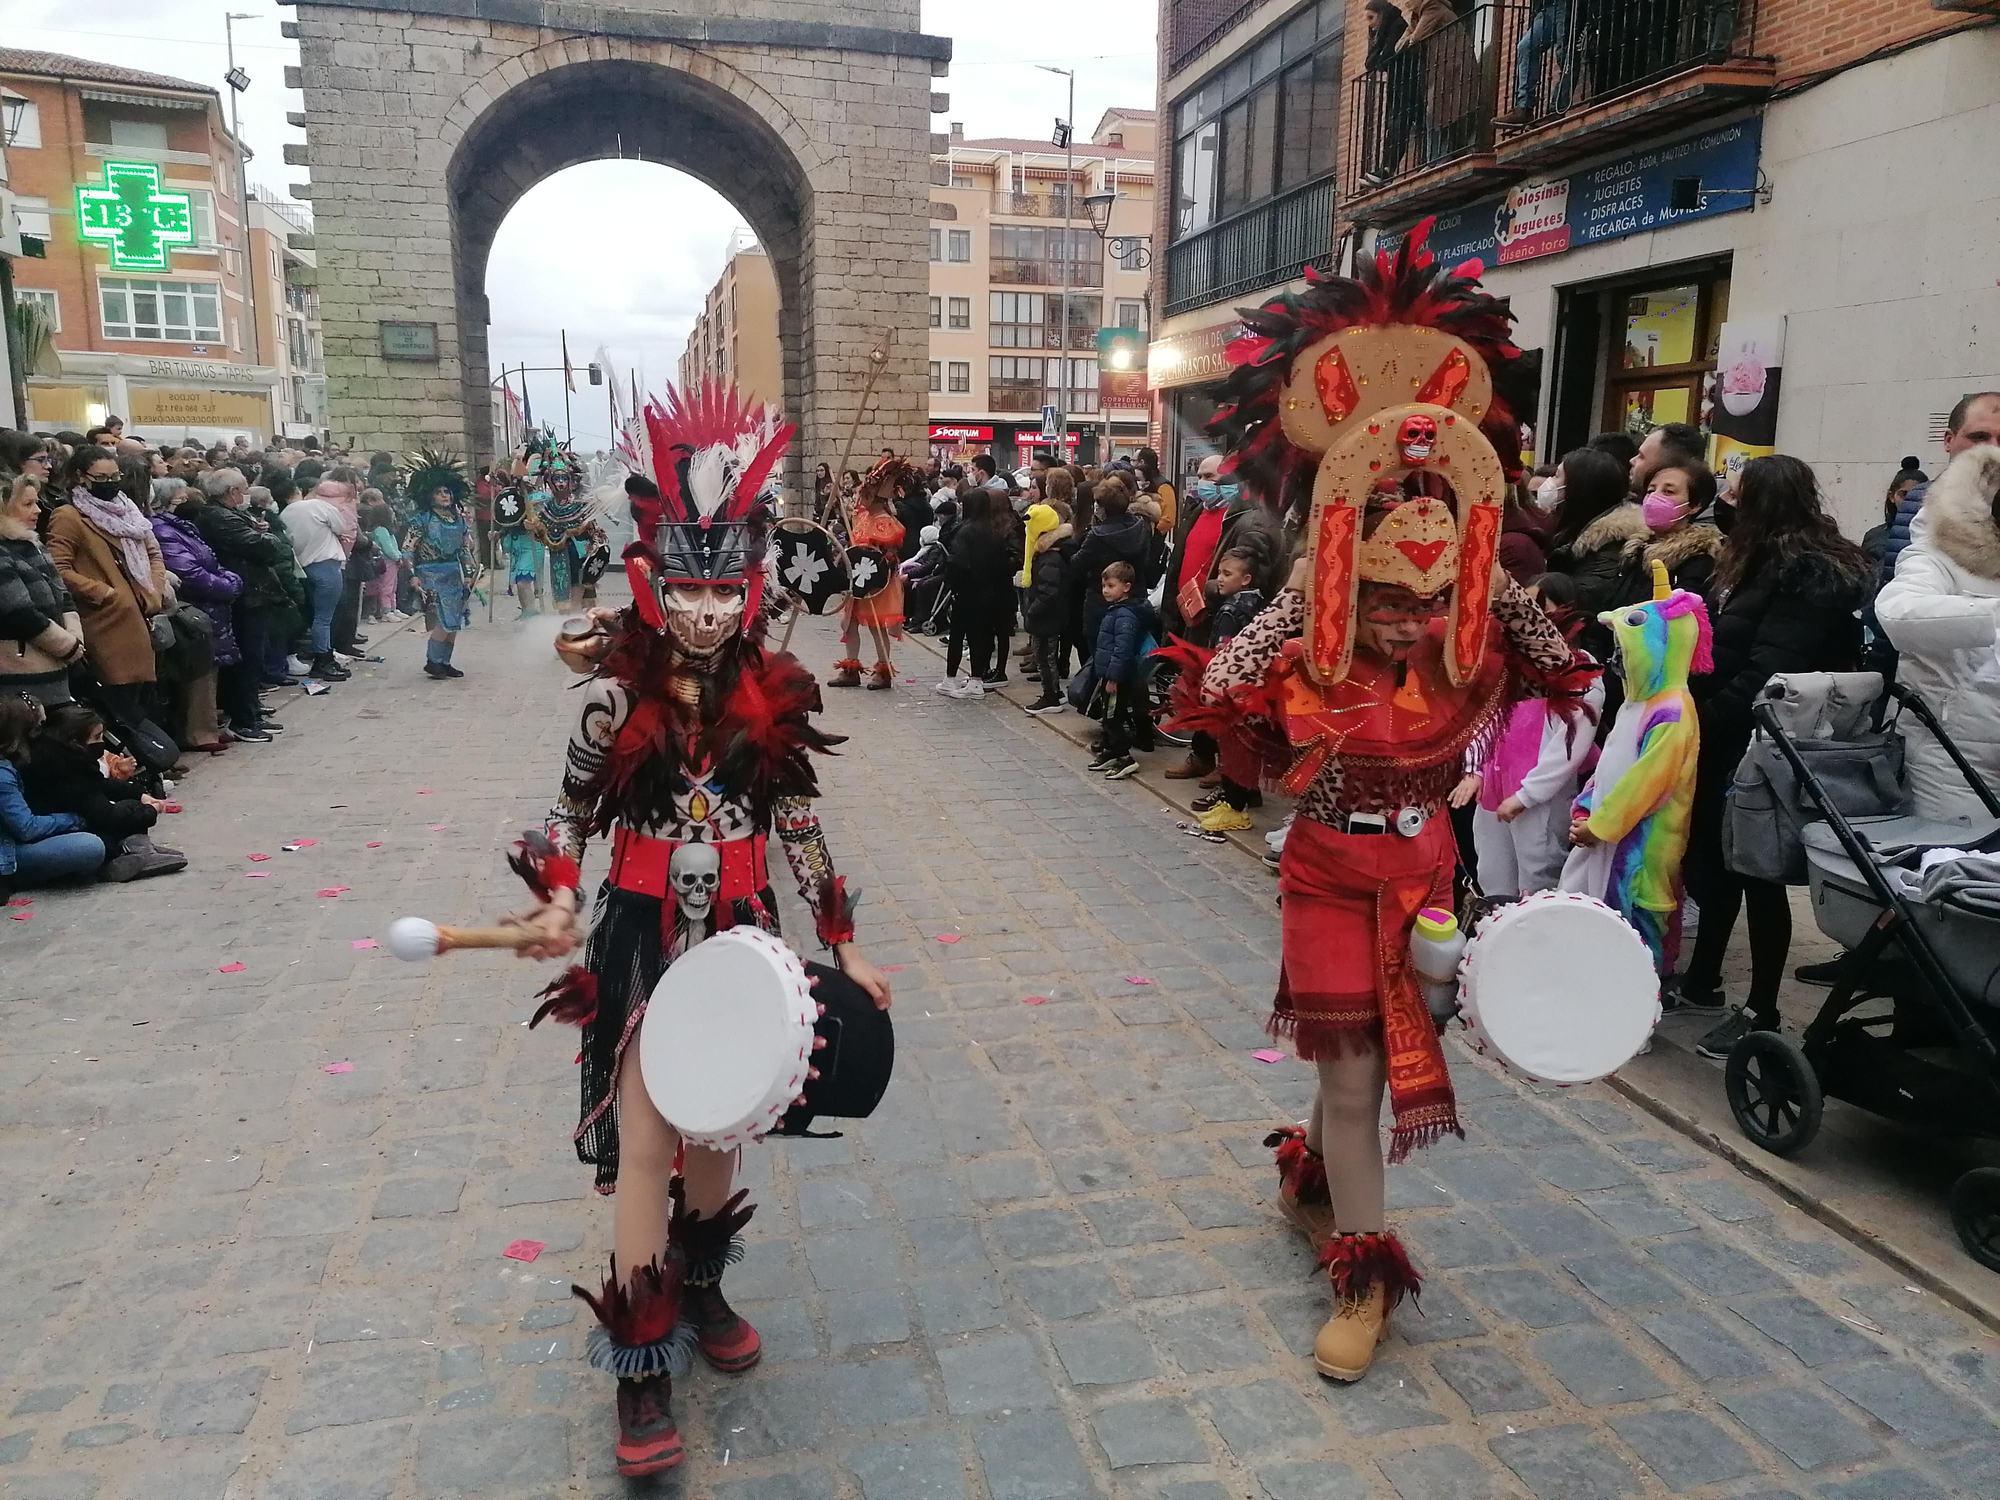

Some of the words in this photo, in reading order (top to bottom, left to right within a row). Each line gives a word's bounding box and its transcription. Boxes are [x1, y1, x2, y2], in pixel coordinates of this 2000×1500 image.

[1594, 161, 1636, 184] REGALO:
[1661, 144, 1690, 163] BAUTIZO
[1693, 141, 1699, 151] Y
[1700, 127, 1742, 150] COMUNIÓN
[1593, 176, 1642, 202] JUGUETES
[100, 204, 133, 227] 13
[1533, 204, 1540, 215] y
[1591, 195, 1644, 221] DISFRACES
[1588, 218, 1637, 239] RECARGA
[1642, 211, 1655, 225] de
[1443, 236, 1495, 260] PLASTIFICADO
[1499, 244, 1535, 262] diseño
[1541, 238, 1566, 252] toro
[149, 360, 173, 376] BAR
[173, 362, 217, 379] TAURUS
[222, 366, 254, 382] TAPAS
[1166, 355, 1210, 381] CARRASCO
[929, 426, 979, 438] SPORTIUM
[1018, 433, 1034, 442] Salón
